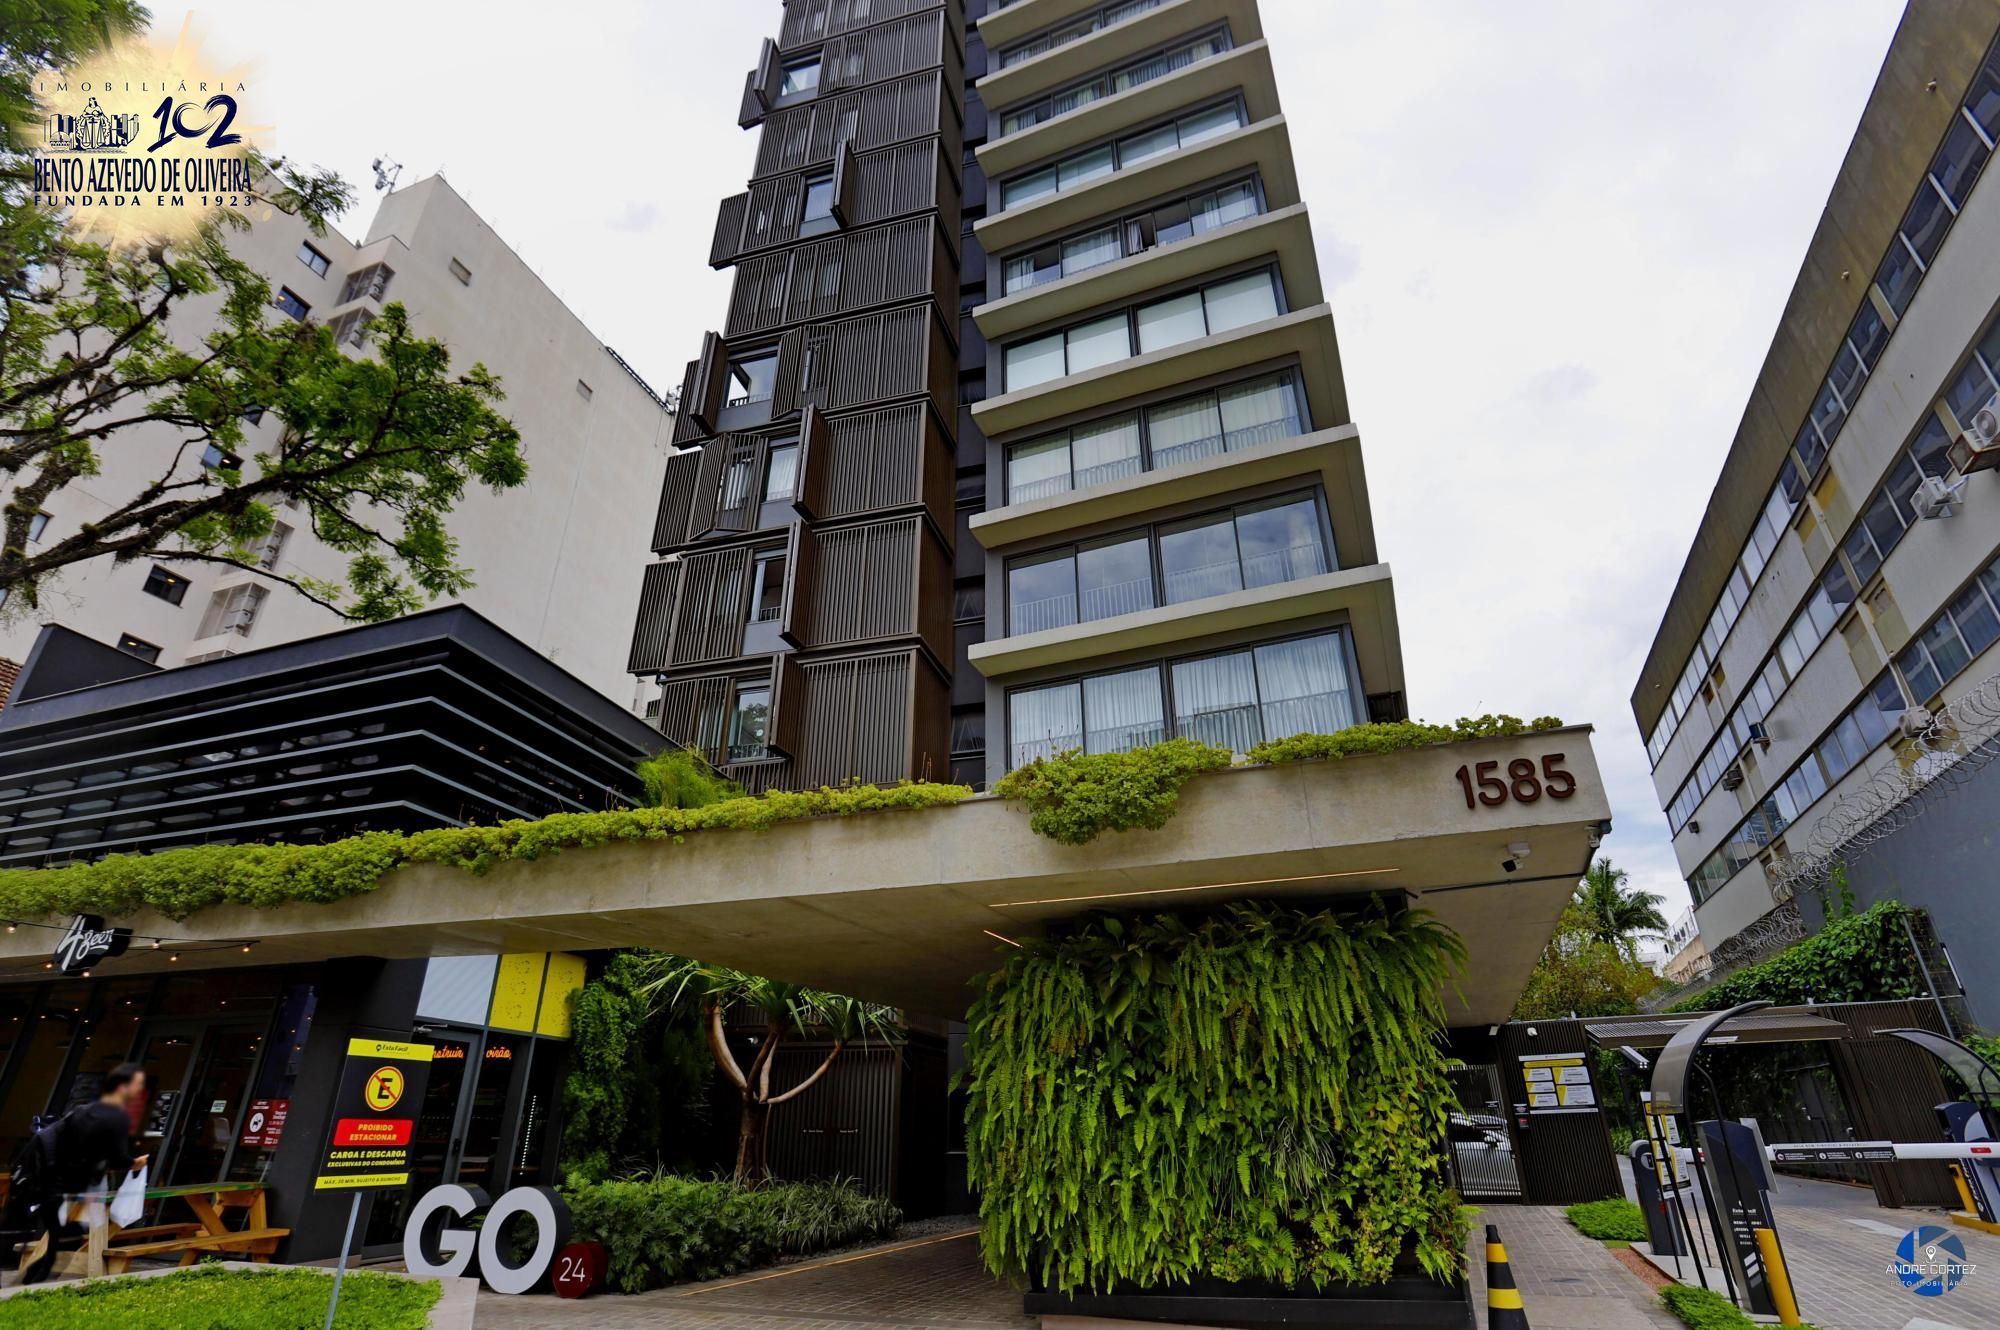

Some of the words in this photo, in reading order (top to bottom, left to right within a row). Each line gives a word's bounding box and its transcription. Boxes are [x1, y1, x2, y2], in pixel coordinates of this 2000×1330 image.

[1456, 753, 1577, 810] 1585
[377, 1078, 393, 1099] E
[330, 1151, 359, 1159] CARGA
[366, 1150, 407, 1158] DESCARGA
[403, 1184, 557, 1294] GO
[559, 1256, 586, 1283] 24
